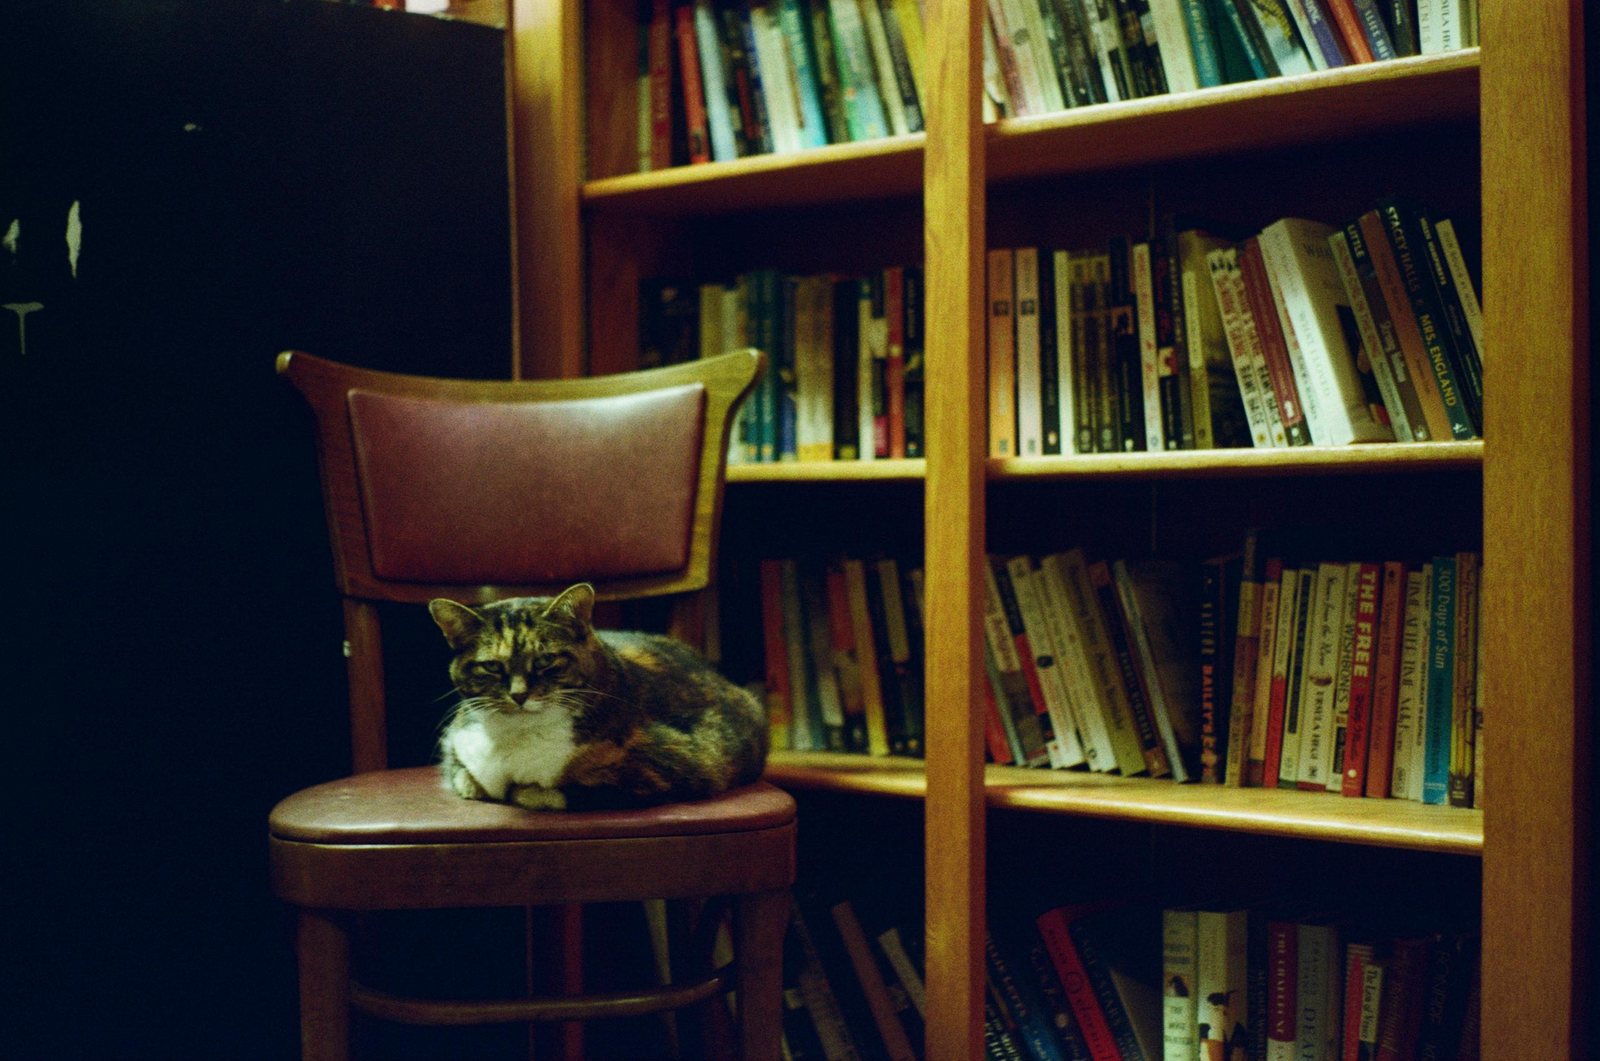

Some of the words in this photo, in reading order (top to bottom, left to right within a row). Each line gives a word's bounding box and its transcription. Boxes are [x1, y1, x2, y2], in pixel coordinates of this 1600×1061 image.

[1347, 224, 1365, 258] LITTLE
[1386, 206, 1409, 250] STACEY
[1400, 251, 1420, 292] HALLS
[1420, 313, 1437, 345] MRS.
[1430, 345, 1456, 407] ENGLAND
[1360, 571, 1377, 615] THE
[1439, 566, 1451, 593] 300
[1434, 594, 1450, 626] Days
[1354, 622, 1373, 678] FREE
[1436, 629, 1449, 643] of
[1340, 624, 1354, 704] WISHBONES
[1435, 643, 1448, 669] Sun
[1366, 970, 1378, 984] The
